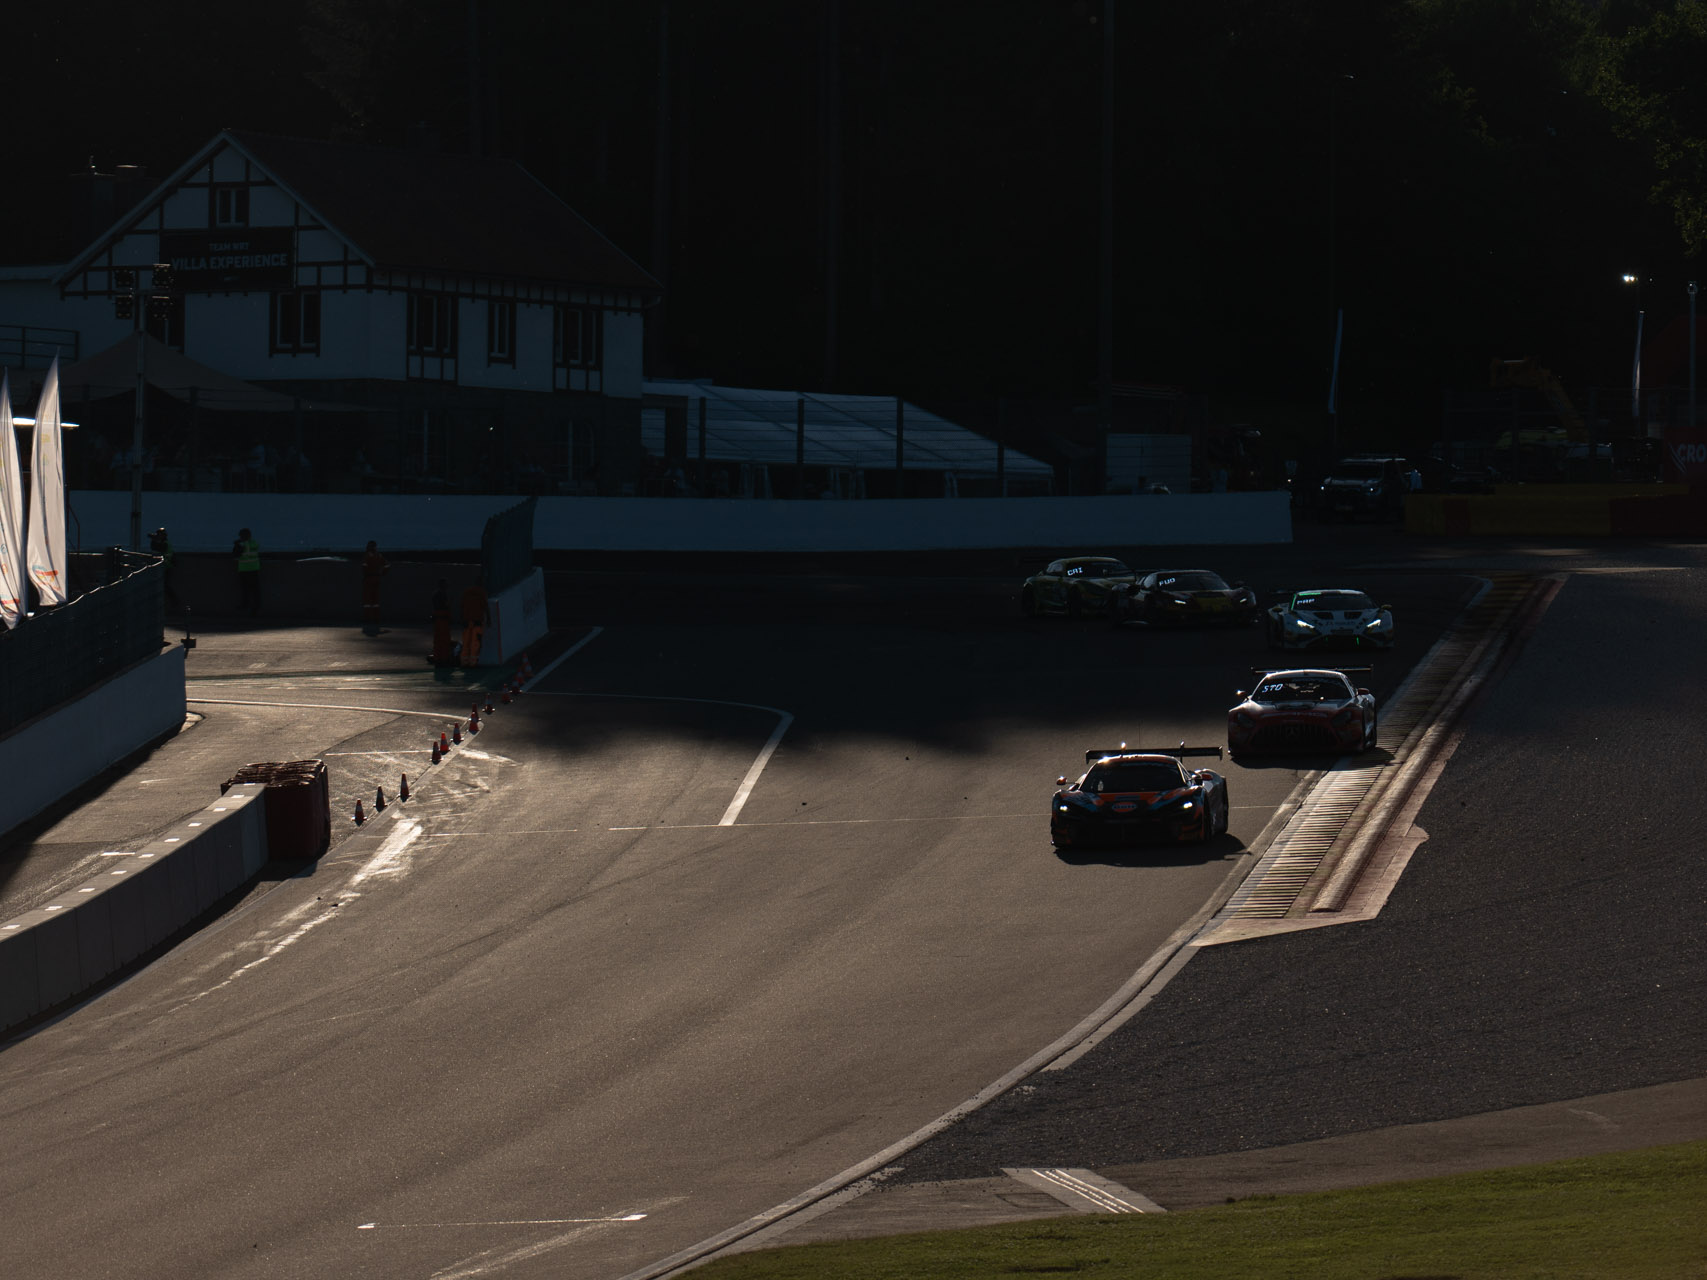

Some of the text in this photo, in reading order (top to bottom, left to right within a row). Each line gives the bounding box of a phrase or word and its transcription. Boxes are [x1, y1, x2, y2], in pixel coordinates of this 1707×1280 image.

[171, 253, 288, 271] VILLA EXPERIENCE
[1261, 683, 1284, 693] STO
